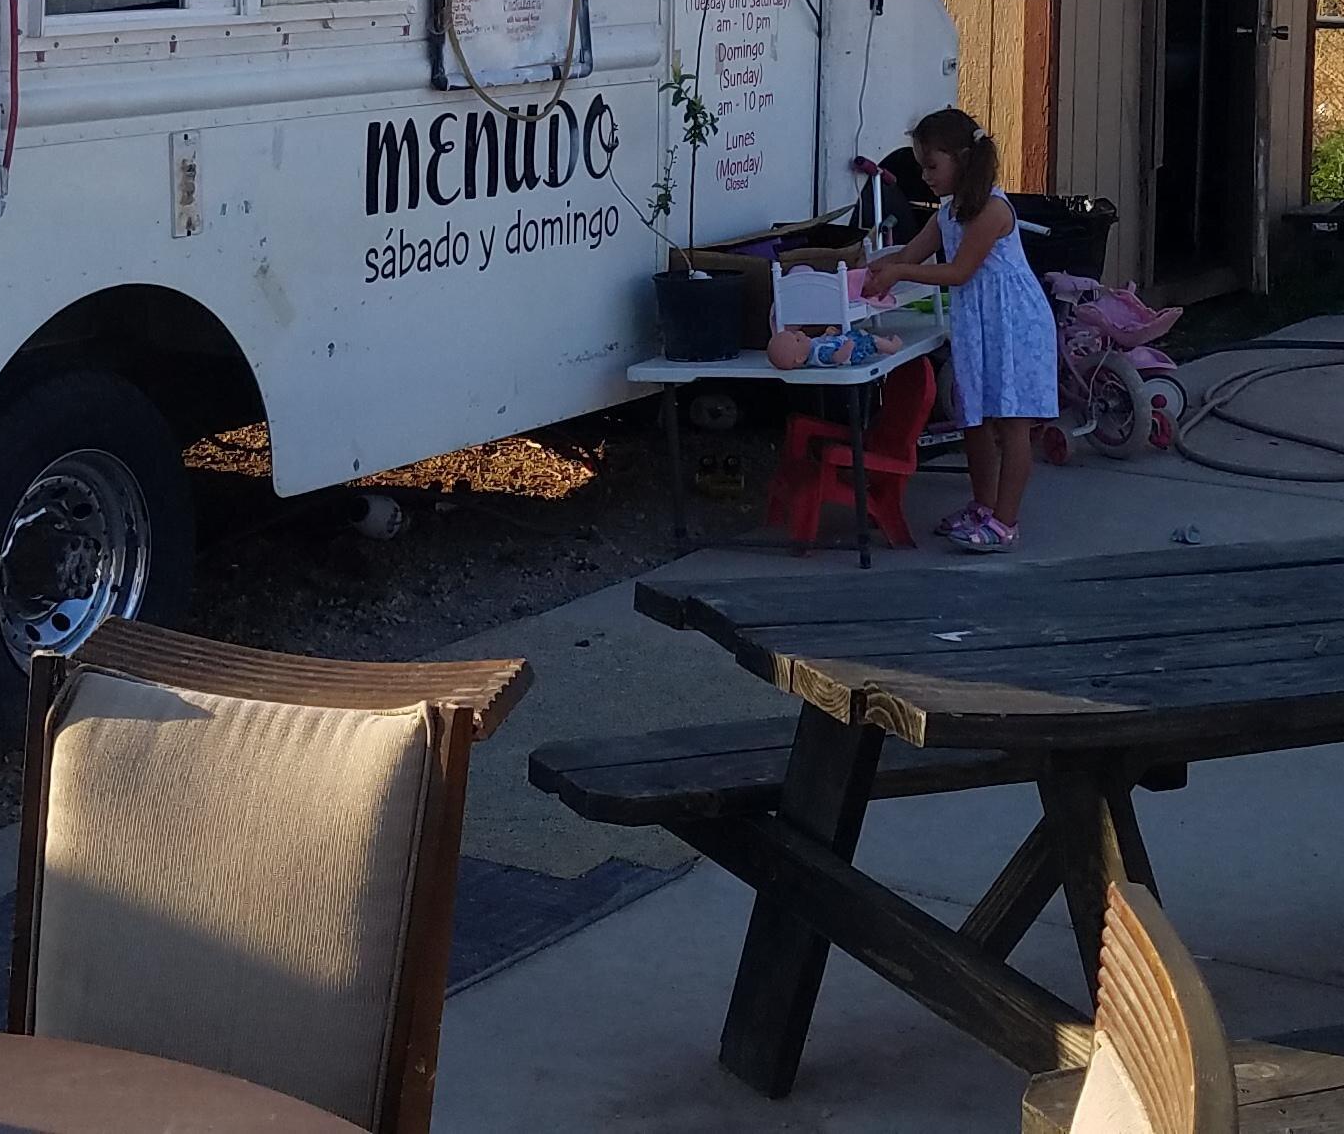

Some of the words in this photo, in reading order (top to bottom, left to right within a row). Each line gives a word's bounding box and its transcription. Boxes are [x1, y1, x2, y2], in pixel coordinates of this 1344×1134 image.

[716, 19, 731, 32] am
[742, 12, 753, 31] 10
[756, 15, 771, 33] pm
[718, 39, 765, 62] Domingo
[719, 63, 763, 91] (Sunday)
[717, 100, 733, 116] am
[743, 91, 756, 113] 10
[758, 93, 774, 112] pm
[726, 131, 755, 151] Lunes
[716, 150, 763, 181] (Monday)
[725, 177, 749, 191] Closed
[364, 221, 469, 284] sábado
[478, 225, 496, 271] y
[505, 200, 619, 254] domingo
